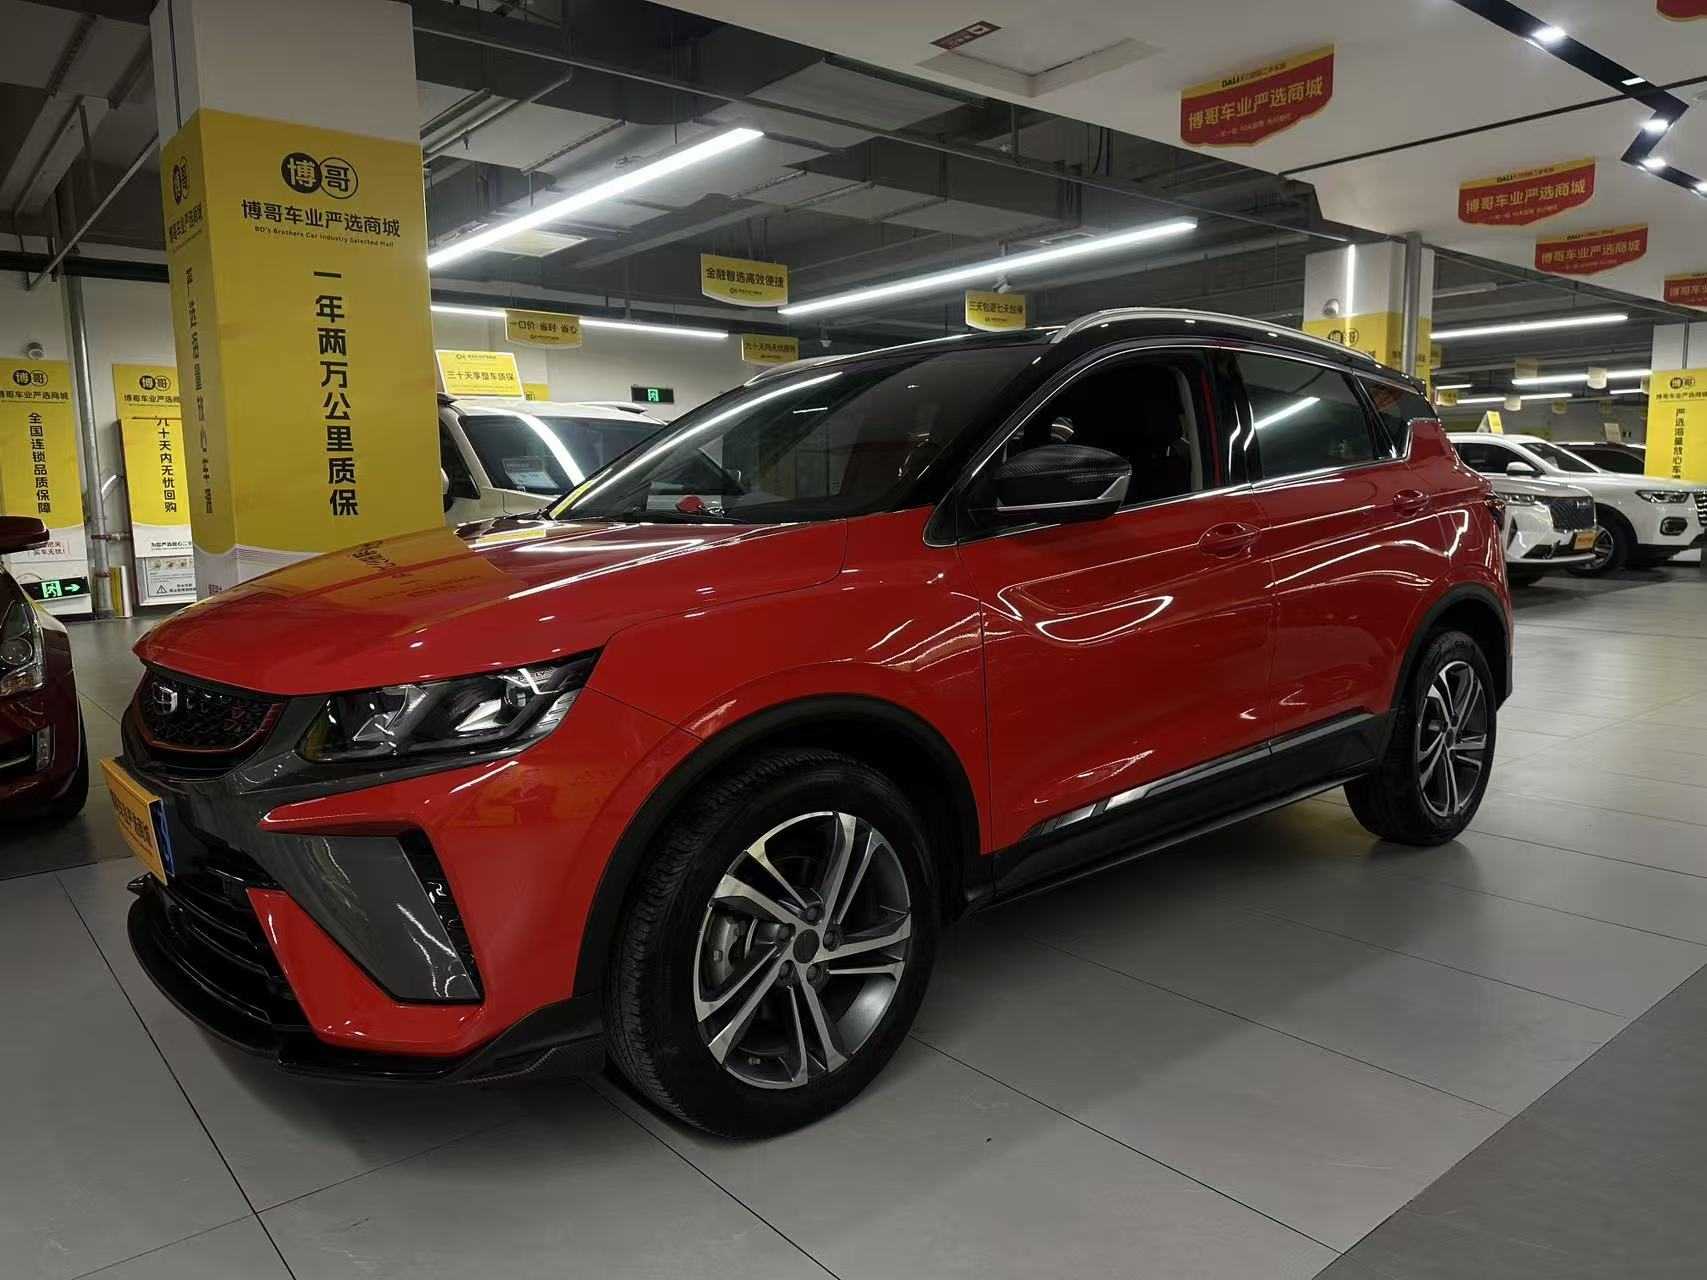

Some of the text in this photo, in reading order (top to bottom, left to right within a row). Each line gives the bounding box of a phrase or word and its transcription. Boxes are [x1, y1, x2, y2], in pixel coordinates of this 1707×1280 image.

[1189, 76, 1323, 130] 博哥车业严选商城
[284, 154, 355, 197] 博哥
[1466, 177, 1586, 214] 博哥车业严选商城
[241, 200, 401, 238] 博哥车业严选商城
[13, 370, 48, 387] 博哥
[140, 375, 171, 392] 博哥
[313, 271, 359, 516] 一年两万公里质保
[28, 412, 51, 514] 全国连锁品质保障
